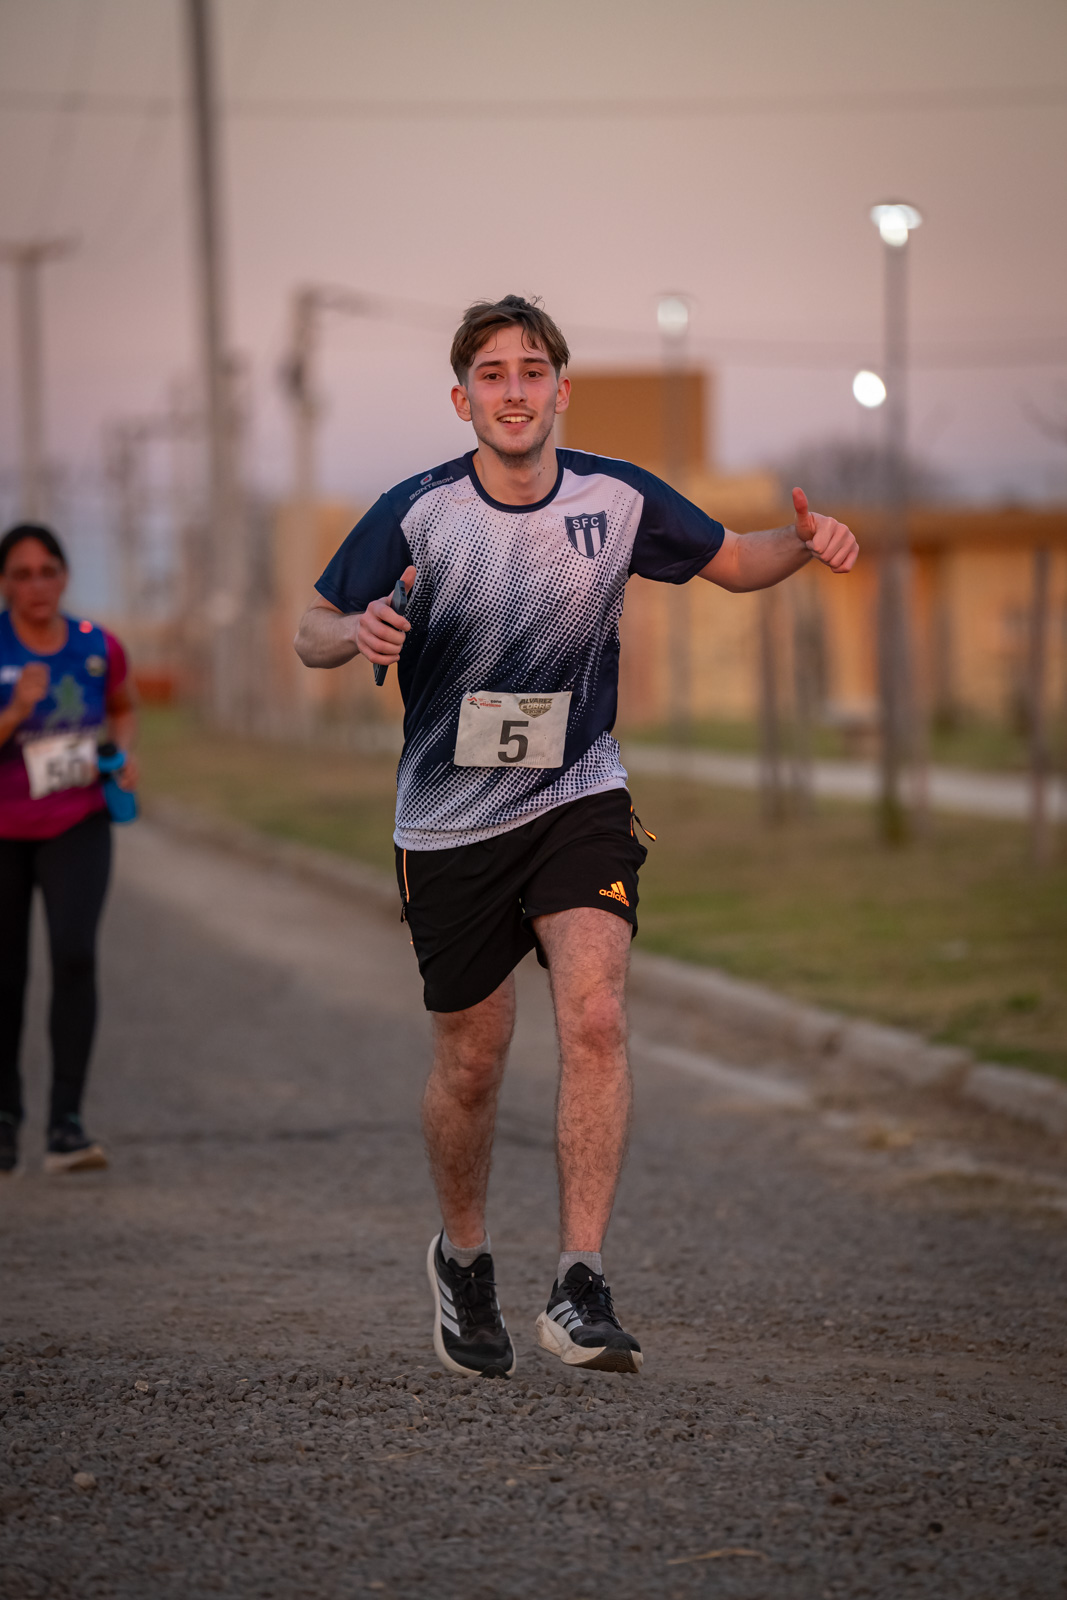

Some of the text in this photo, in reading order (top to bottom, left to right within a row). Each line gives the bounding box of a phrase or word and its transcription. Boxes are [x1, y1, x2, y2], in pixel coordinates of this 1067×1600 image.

[572, 516, 600, 530] SFC
[497, 720, 529, 763] 5
[598, 888, 630, 907] adidas
